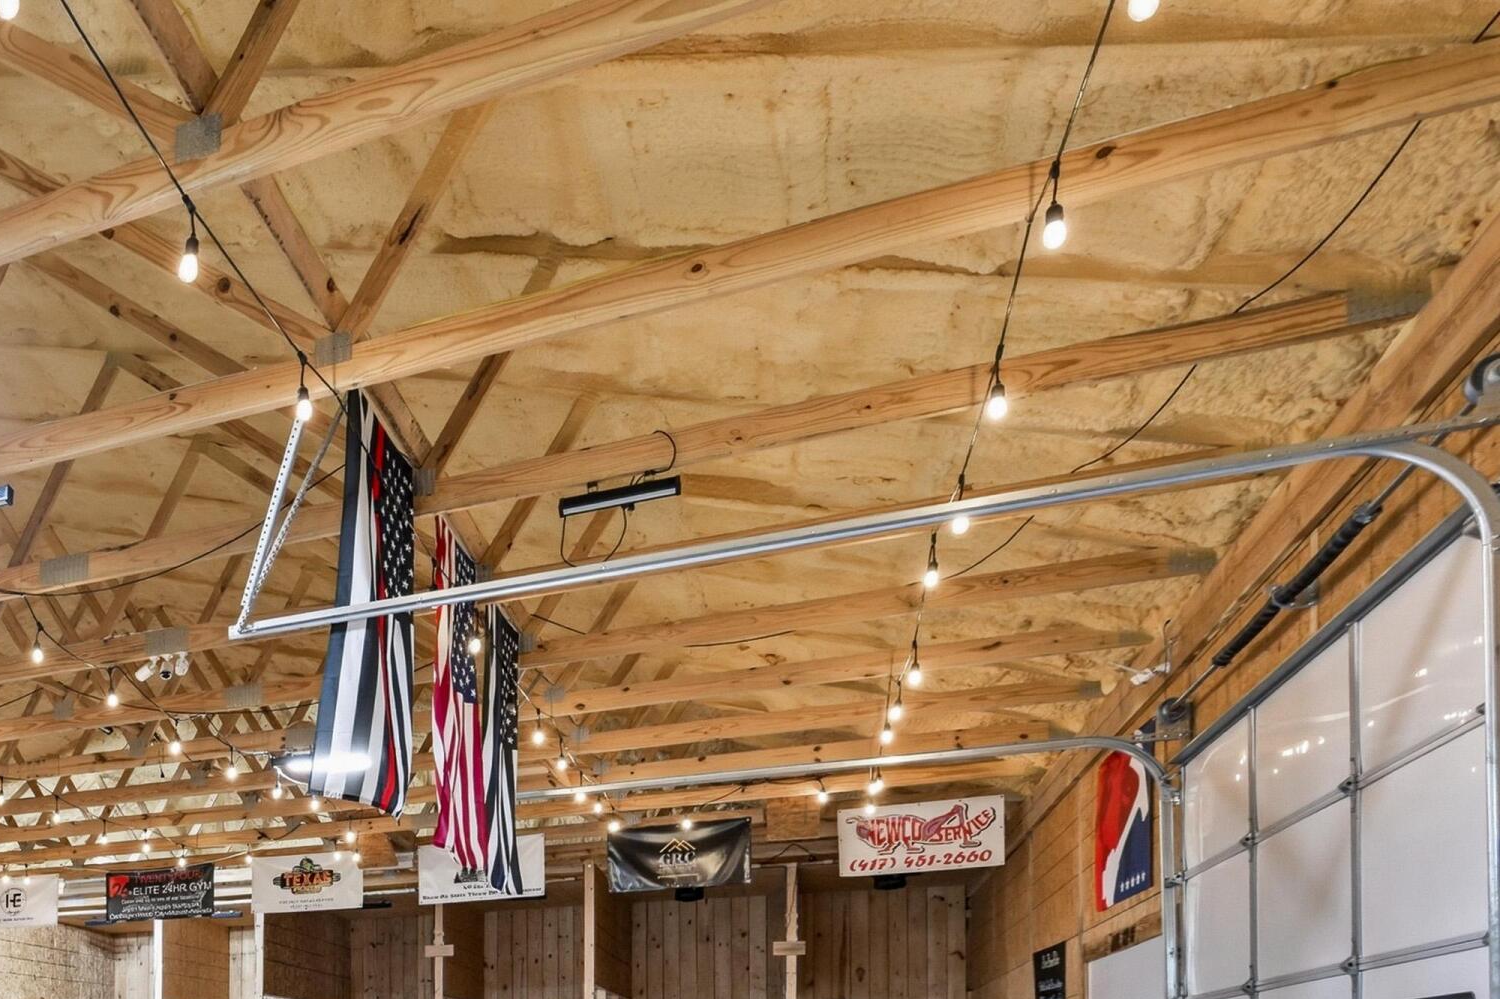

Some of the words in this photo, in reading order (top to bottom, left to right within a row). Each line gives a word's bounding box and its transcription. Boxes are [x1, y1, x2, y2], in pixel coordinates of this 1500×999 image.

[849, 857, 896, 872] (417)
[285, 869, 333, 886] TEXAS
[133, 885, 160, 896] ELITE
[189, 880, 213, 891] GYM
